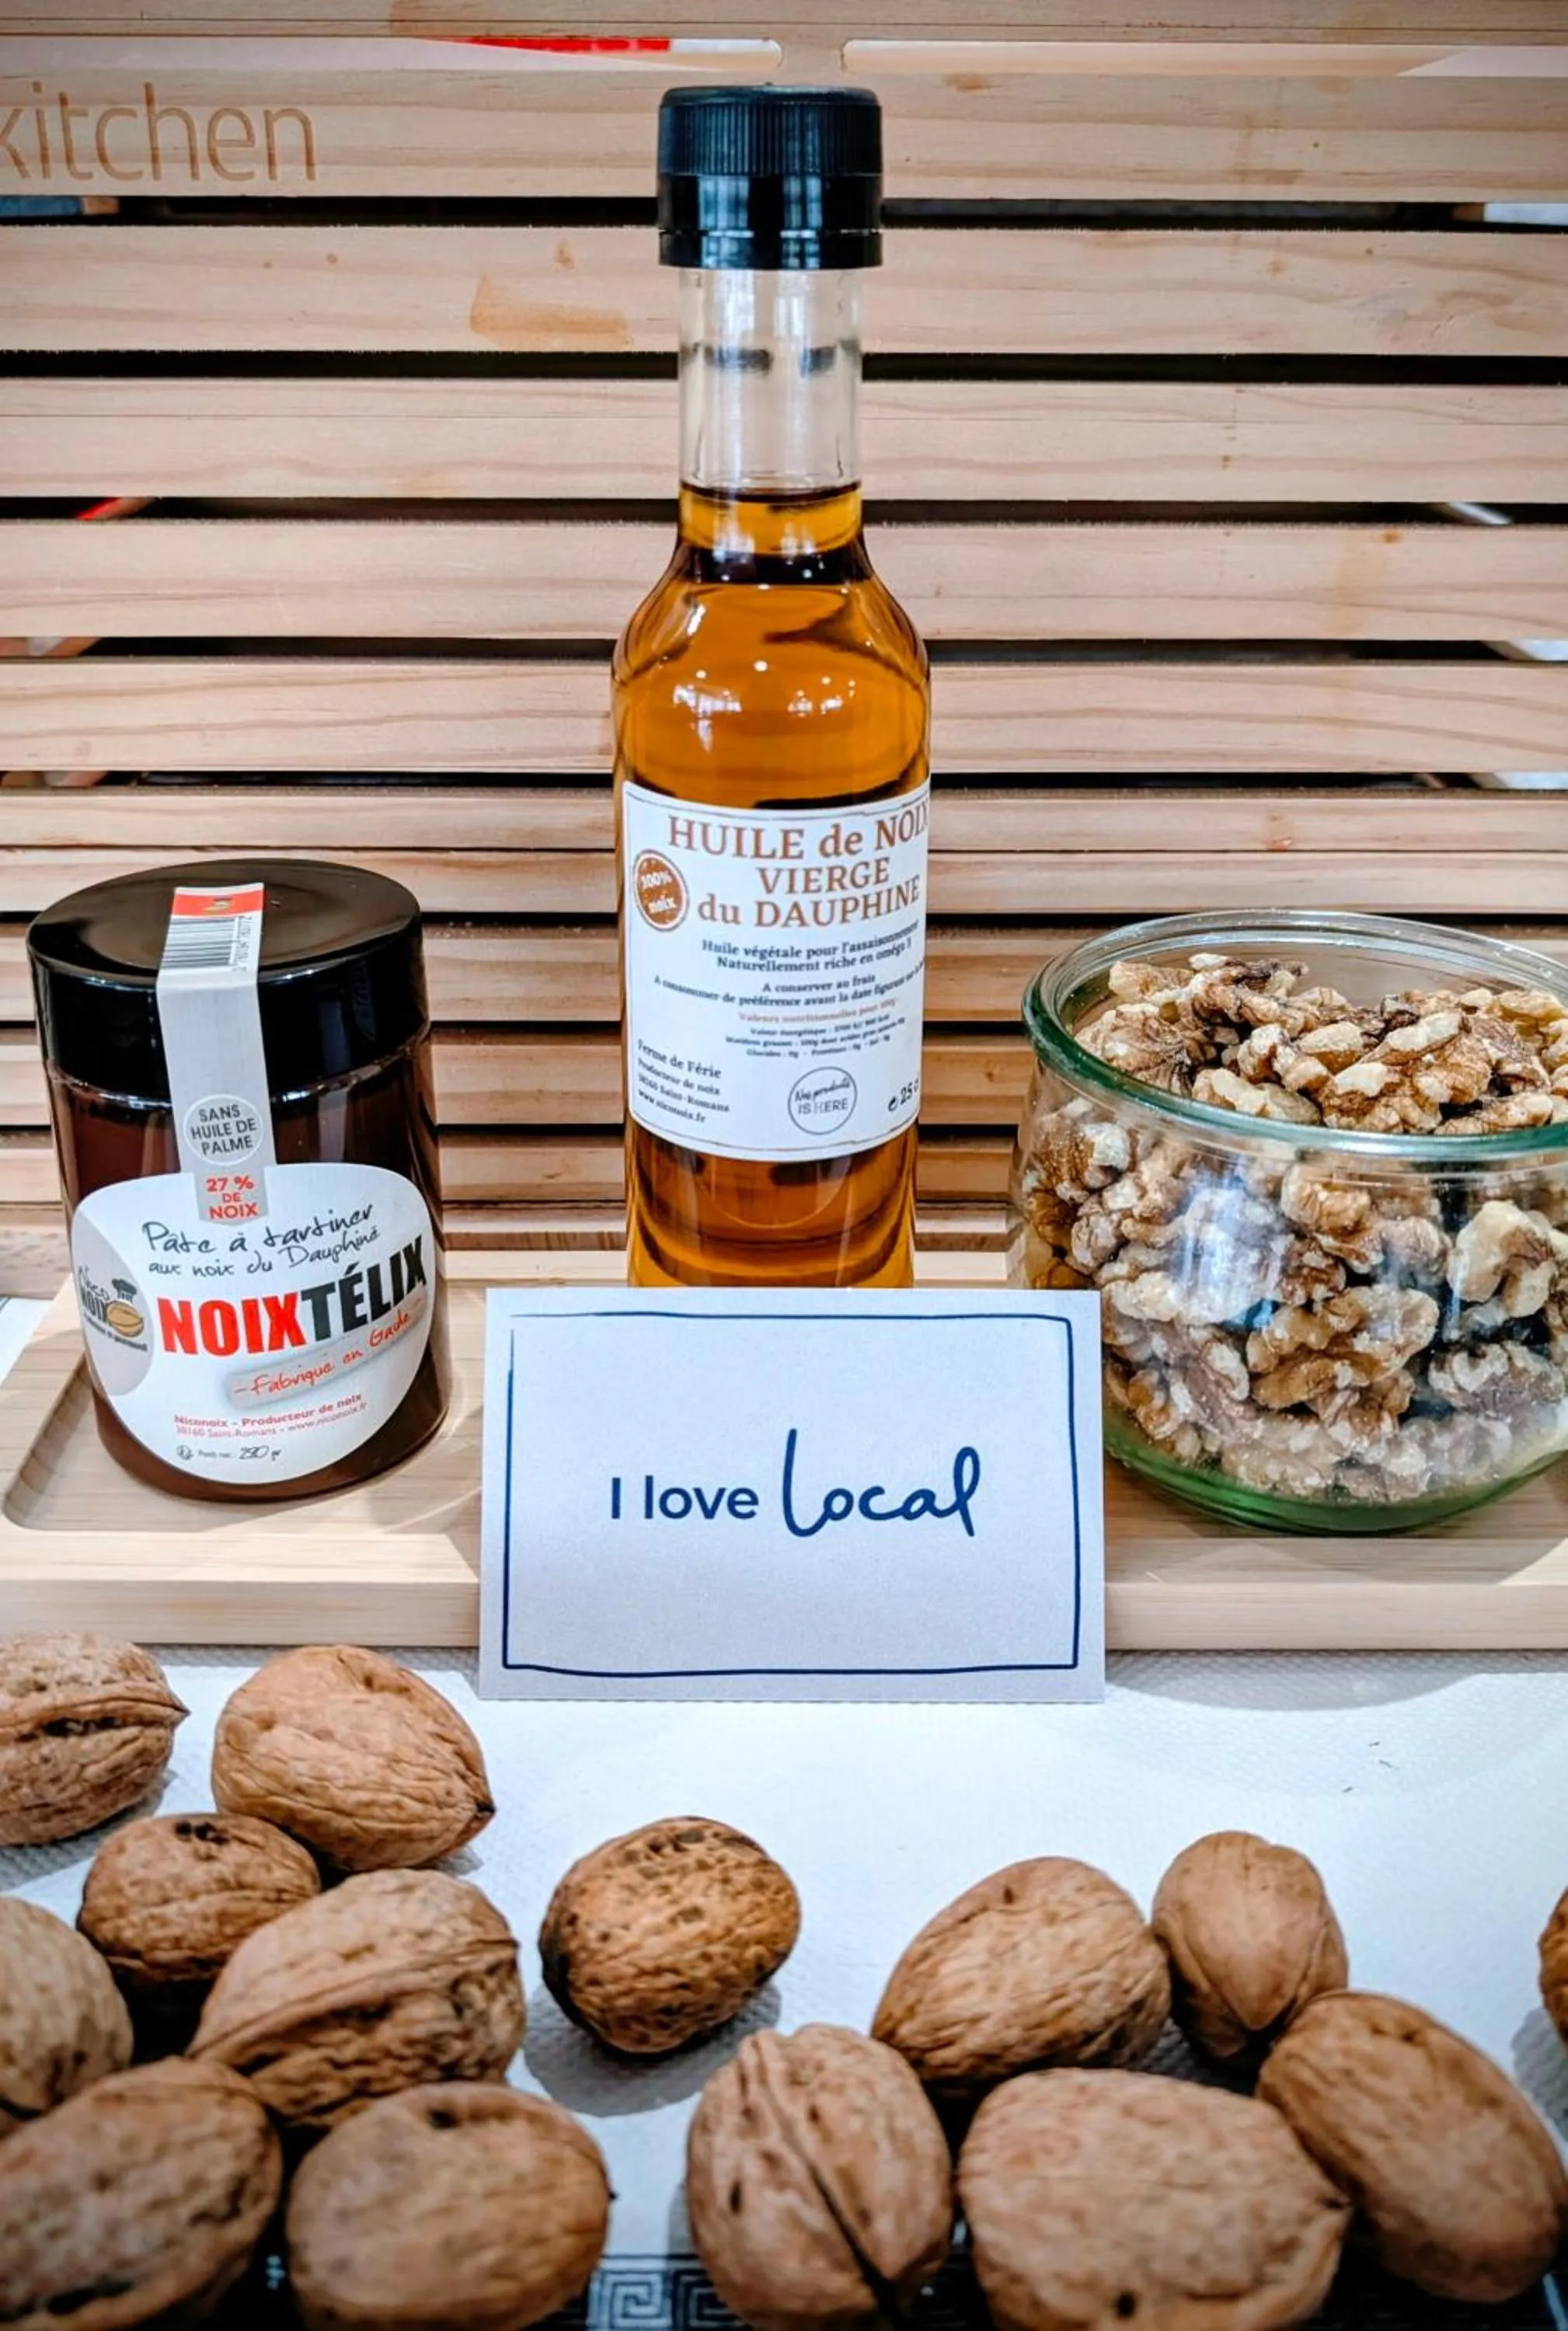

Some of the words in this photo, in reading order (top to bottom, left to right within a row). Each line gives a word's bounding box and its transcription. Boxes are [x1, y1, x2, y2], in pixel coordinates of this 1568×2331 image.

[0, 81, 316, 182] kitchen
[668, 815, 805, 860] HUILE
[819, 823, 863, 859] de
[755, 856, 890, 895] VIERGE
[698, 893, 743, 925] du
[754, 874, 921, 928] DAUPHINE
[702, 938, 740, 956] Huile
[743, 944, 803, 961] végétale
[806, 946, 838, 960] pour
[716, 956, 821, 972] Naturellement
[824, 956, 857, 970] riche
[859, 953, 873, 965] en
[723, 991, 737, 1003] de
[775, 981, 833, 994] conserver
[669, 1054, 685, 1070] de
[198, 1104, 241, 1123] SANS
[190, 1121, 233, 1140] HUILE
[235, 1117, 258, 1134] DE
[200, 1134, 254, 1156] PALME
[206, 1176, 228, 1193] 27
[234, 1175, 255, 1190] %
[221, 1193, 242, 1204] DE
[208, 1202, 258, 1220] NOIX
[142, 1221, 217, 1253] Pâte
[228, 1232, 249, 1253] à
[263, 1204, 374, 1247] tartiner
[148, 1262, 182, 1276] aux
[192, 1259, 235, 1279] noix
[246, 1250, 274, 1274] du
[277, 1225, 382, 1269] Dauphiné
[342, 1349, 364, 1366] en
[242, 1409, 317, 1427] Producteur
[318, 1404, 334, 1414] de
[336, 1393, 362, 1409] noix
[611, 1478, 620, 1519] I
[643, 1476, 759, 1520] love
